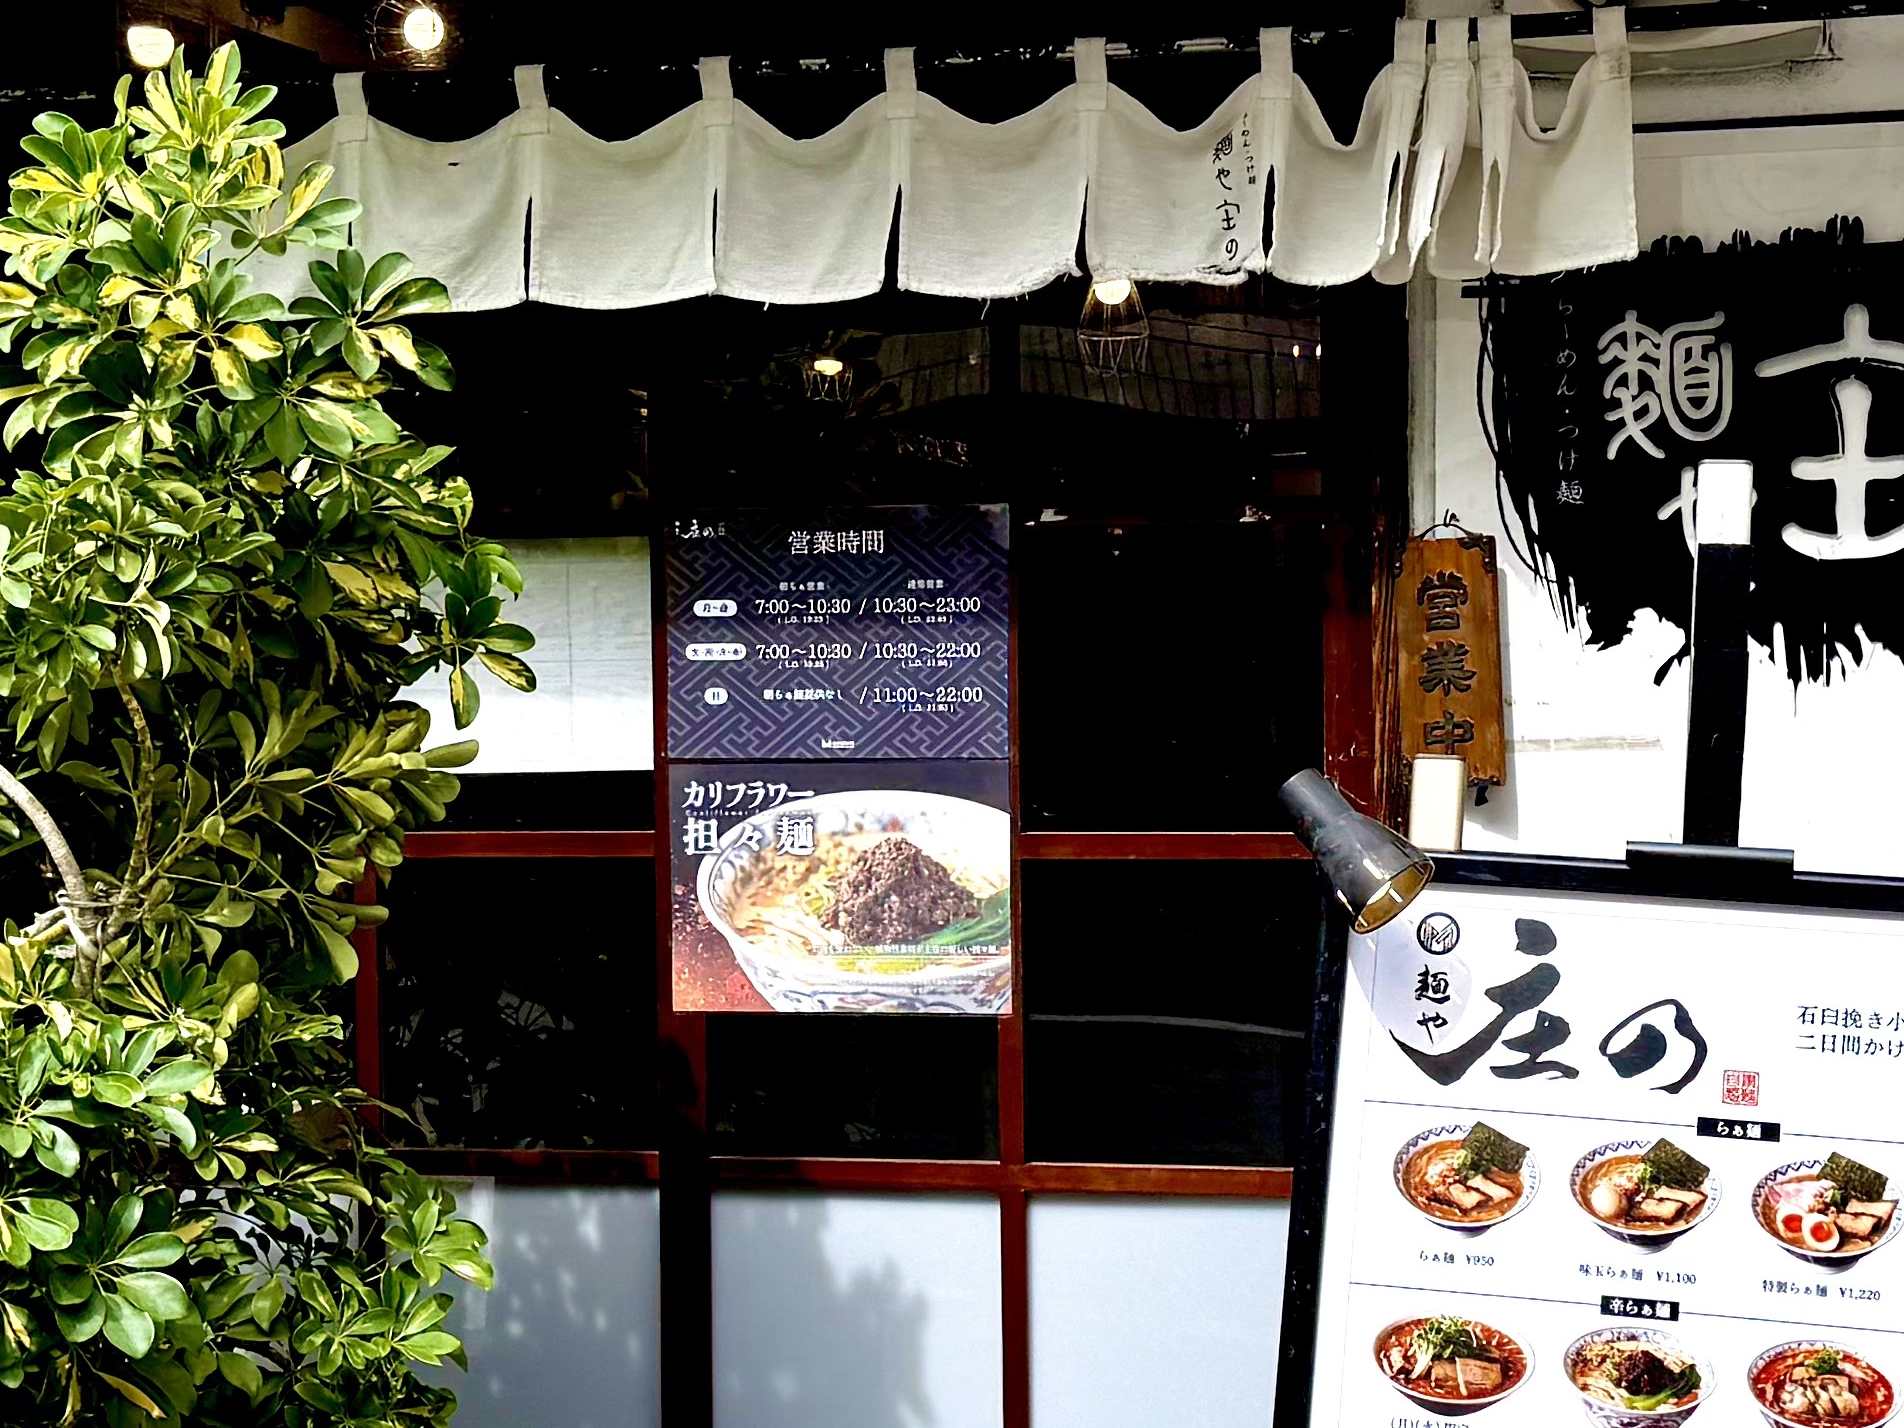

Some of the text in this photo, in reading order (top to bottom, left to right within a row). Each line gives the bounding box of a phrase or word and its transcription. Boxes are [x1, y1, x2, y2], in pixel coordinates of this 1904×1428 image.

[787, 529, 886, 556] 営業時間
[681, 780, 815, 809] カリフラワー
[682, 816, 816, 856] 担々麺
